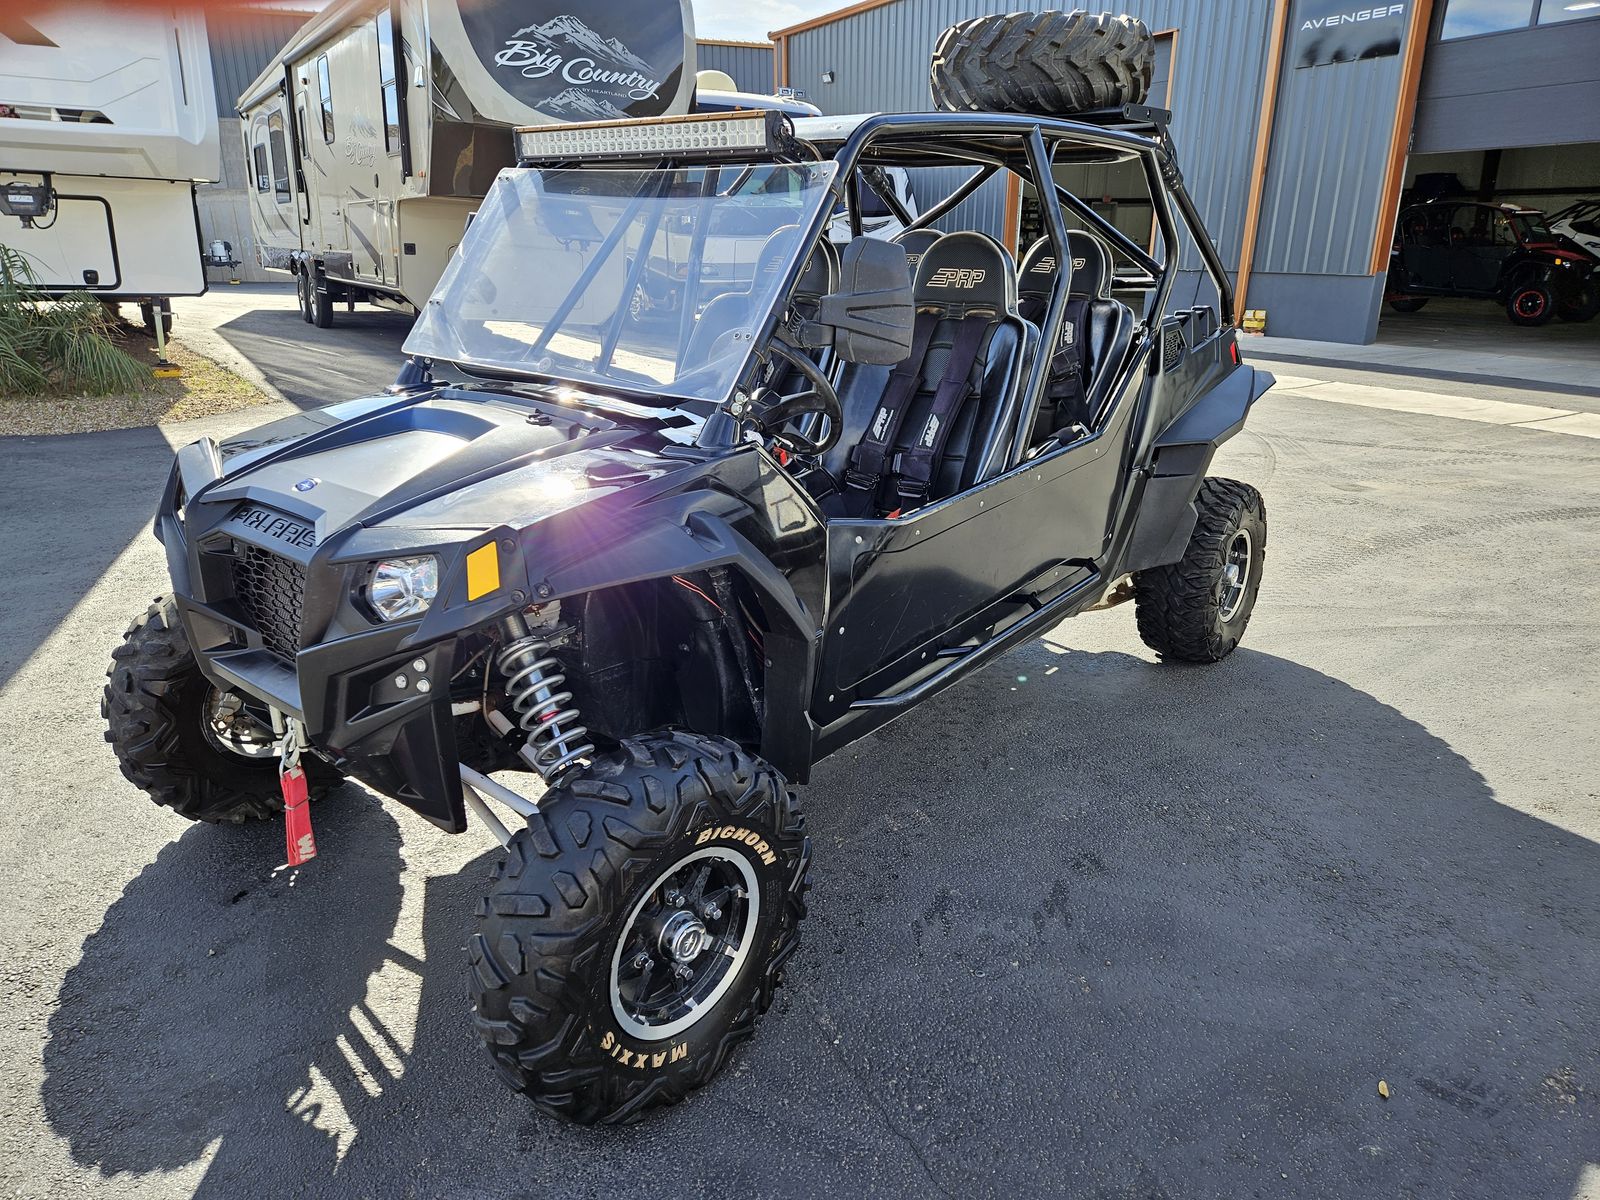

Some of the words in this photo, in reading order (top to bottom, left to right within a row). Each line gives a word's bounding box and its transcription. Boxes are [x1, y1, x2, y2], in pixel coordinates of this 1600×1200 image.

[1301, 4, 1404, 31] AVENGER
[494, 40, 563, 78] Big
[561, 57, 661, 100] Country
[591, 89, 627, 98] HEARTLAND
[926, 268, 986, 289] PRP
[872, 407, 888, 440] PRP
[229, 506, 316, 551] POLARIS
[695, 824, 777, 866] BIGHORN
[600, 1031, 688, 1069] MAXXIS
